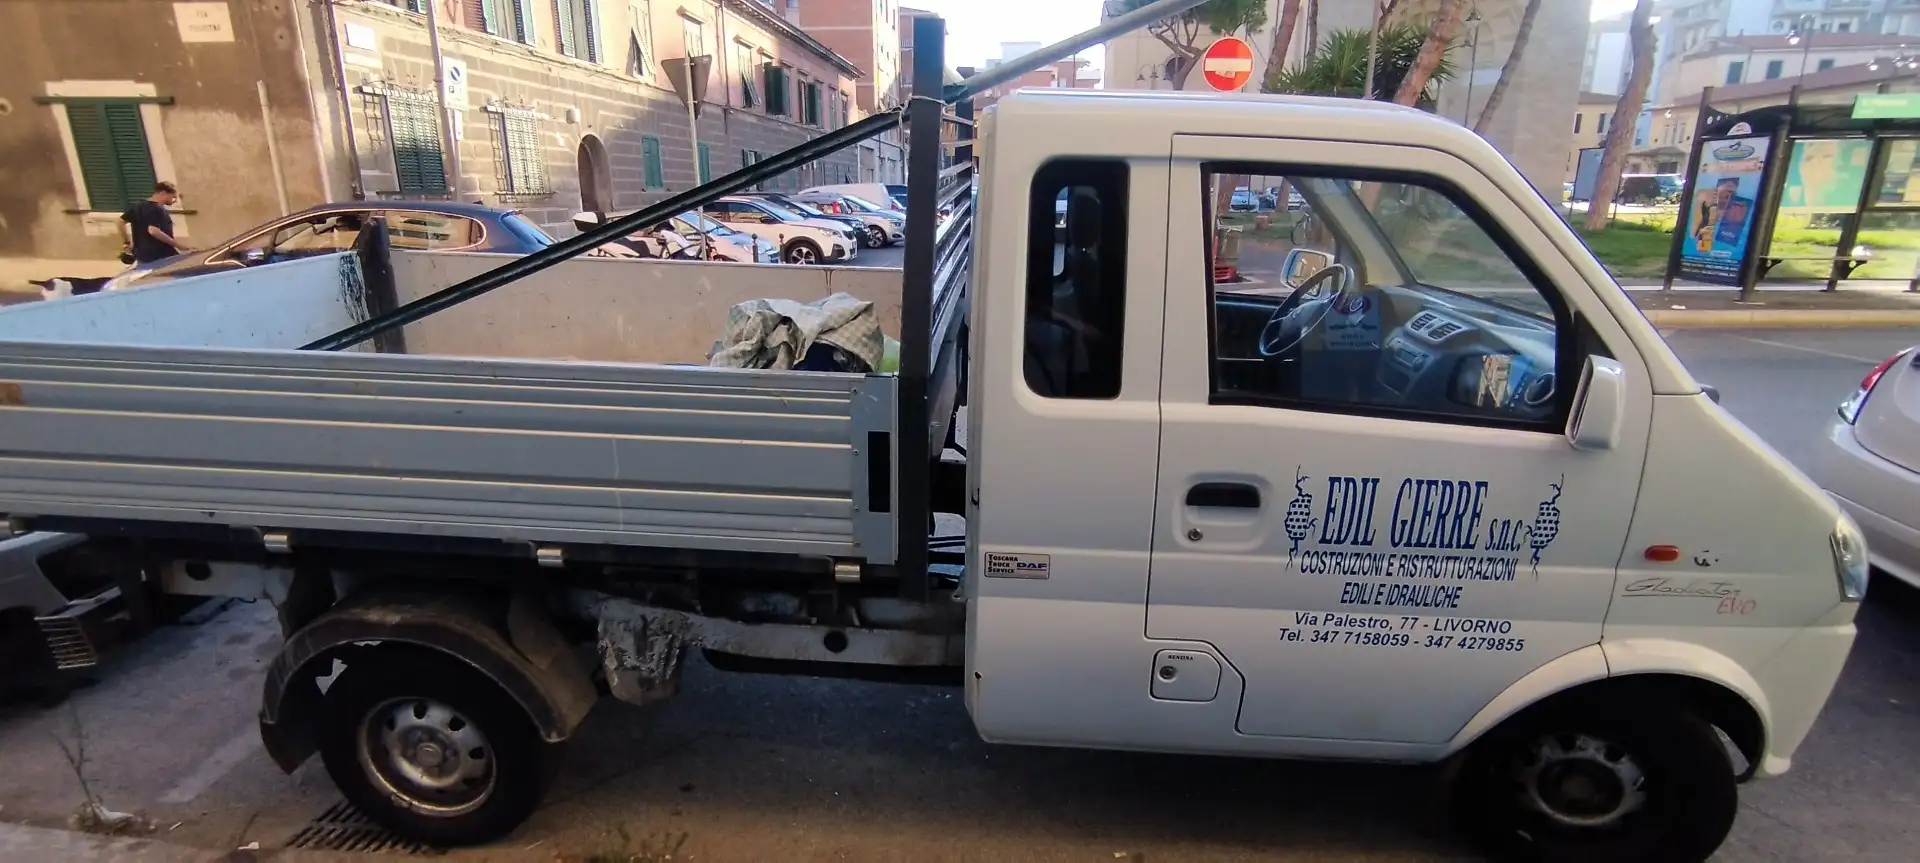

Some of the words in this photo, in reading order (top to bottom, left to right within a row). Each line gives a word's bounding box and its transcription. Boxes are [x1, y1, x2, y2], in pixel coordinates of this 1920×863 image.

[1319, 476, 1380, 546] EDIL
[1390, 478, 1488, 549] GIERRE
[1300, 550, 1385, 576] COSTRUZIONI
[1386, 554, 1397, 576] E
[1397, 554, 1519, 581] RISTRUTTURAZIONI
[1340, 582, 1375, 605] EDILI
[1374, 583, 1386, 605] E
[1385, 584, 1463, 608] IDRAULICHE
[1295, 612, 1318, 626] Via
[1323, 613, 1393, 632] Palestro,
[1400, 617, 1419, 630] 77
[1433, 618, 1512, 634] LIVORNO
[1280, 628, 1304, 642] Tel.
[1311, 630, 1339, 643] 347
[1343, 631, 1410, 647] 7158059
[1424, 635, 1454, 648] 347
[1457, 637, 1525, 652] 4279855
